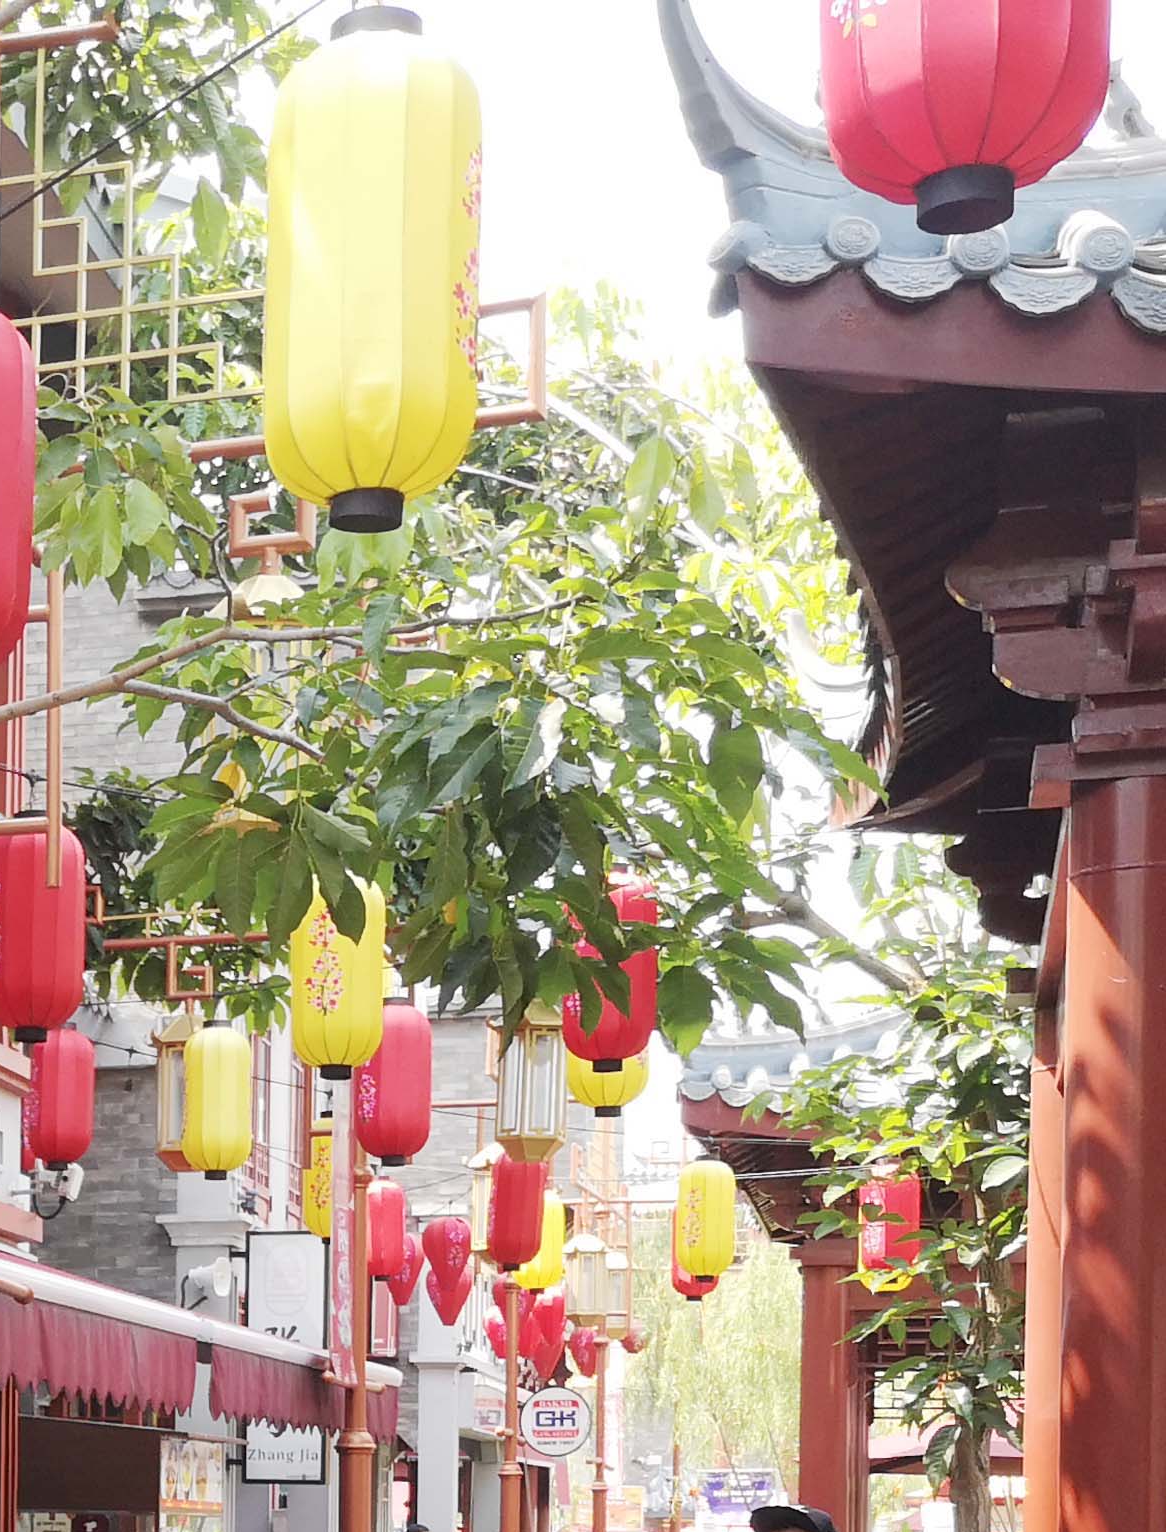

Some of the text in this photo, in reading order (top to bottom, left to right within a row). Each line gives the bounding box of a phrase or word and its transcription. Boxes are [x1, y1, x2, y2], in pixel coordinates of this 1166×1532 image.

[536, 1410, 576, 1427] GK
[248, 1448, 319, 1464] Zhang Jia
